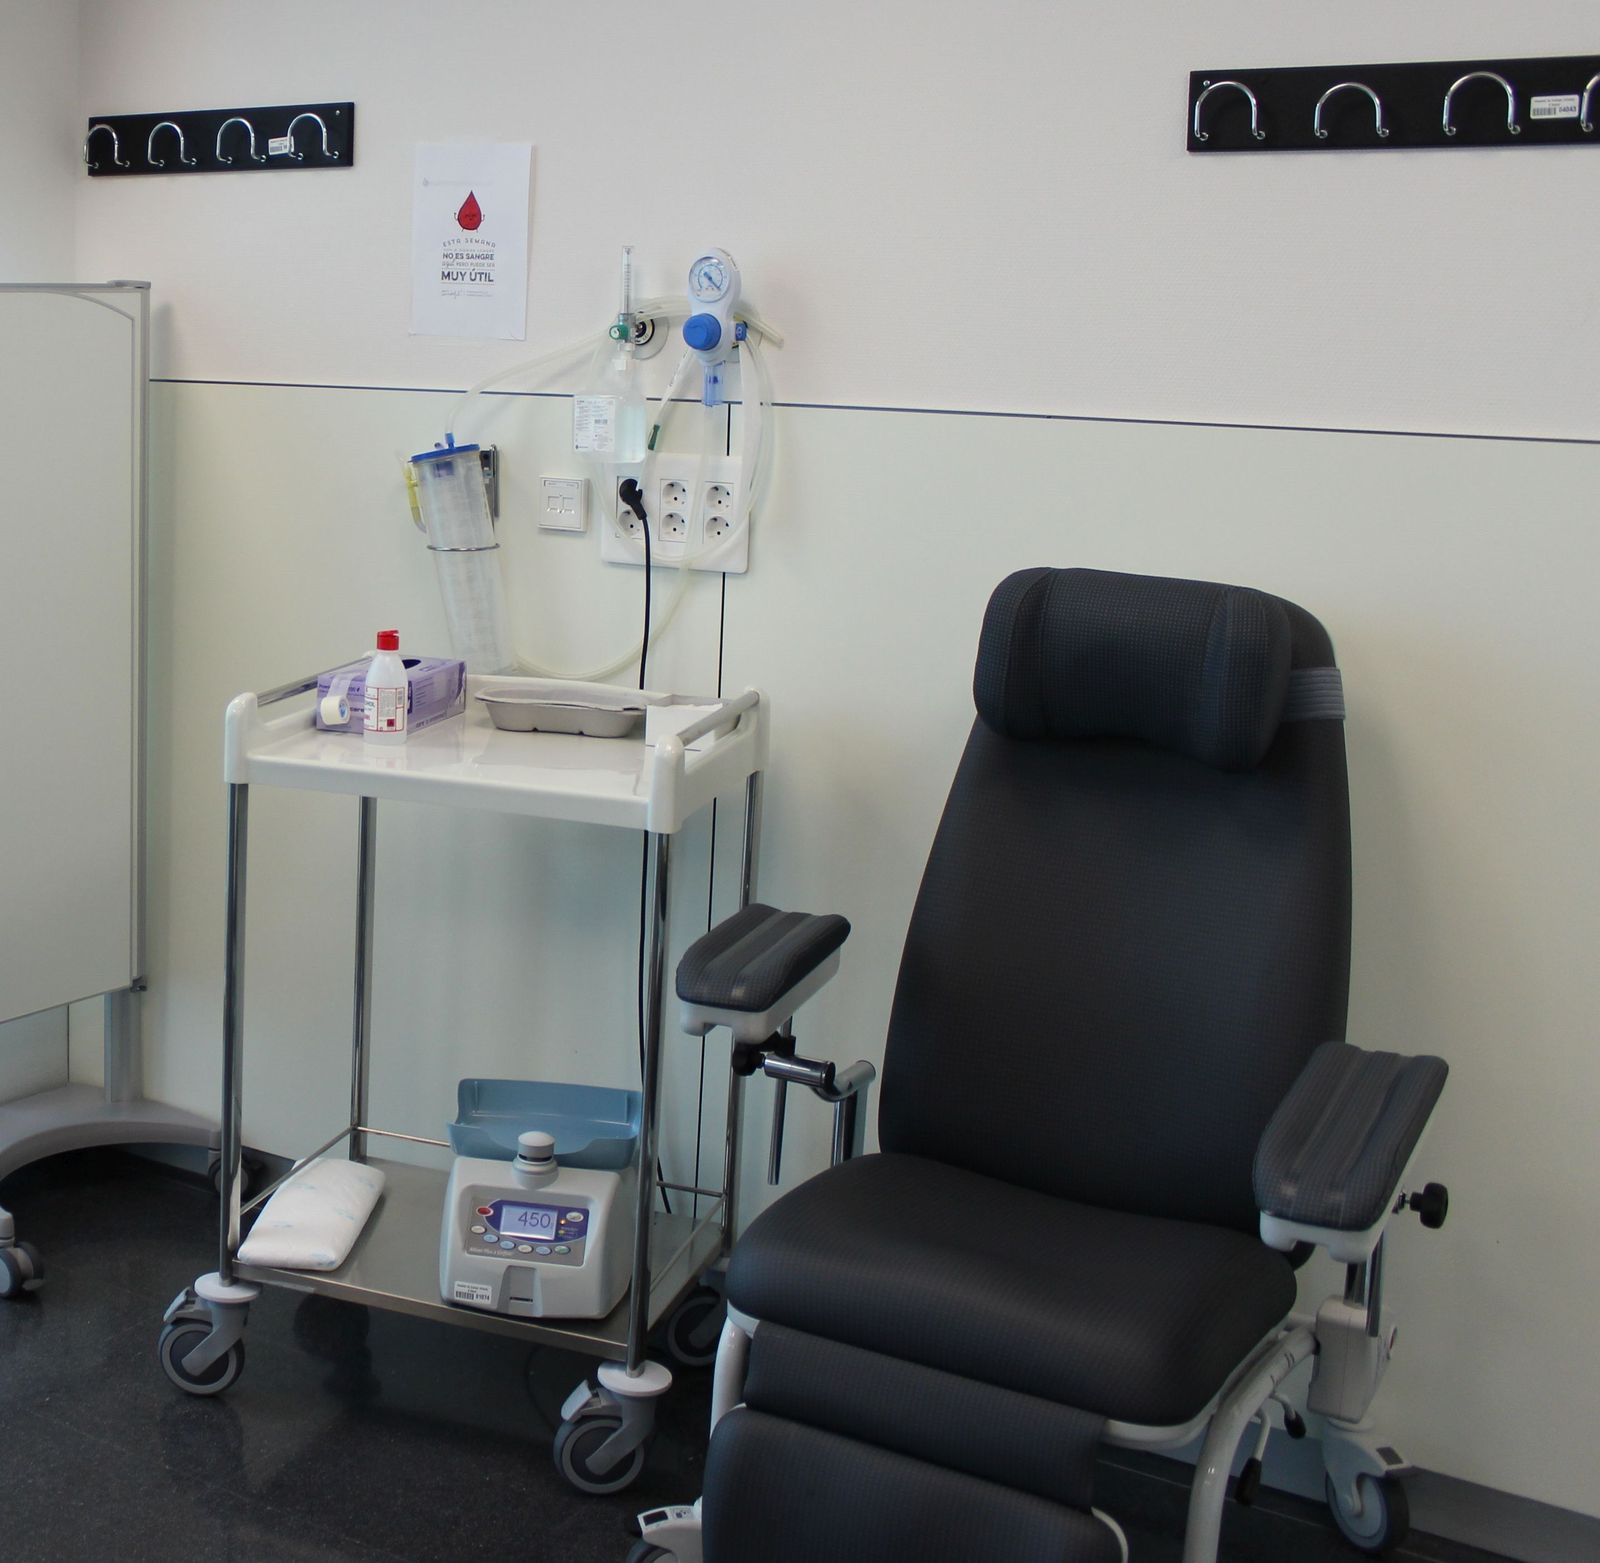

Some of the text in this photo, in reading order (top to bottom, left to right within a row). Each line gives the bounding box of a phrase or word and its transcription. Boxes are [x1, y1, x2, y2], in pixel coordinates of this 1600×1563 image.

[466, 238, 496, 249] SEMANA
[443, 252, 495, 261] NO ES SANGRE
[441, 268, 494, 283] MUY ÚTIL
[518, 1210, 551, 1229] 450
